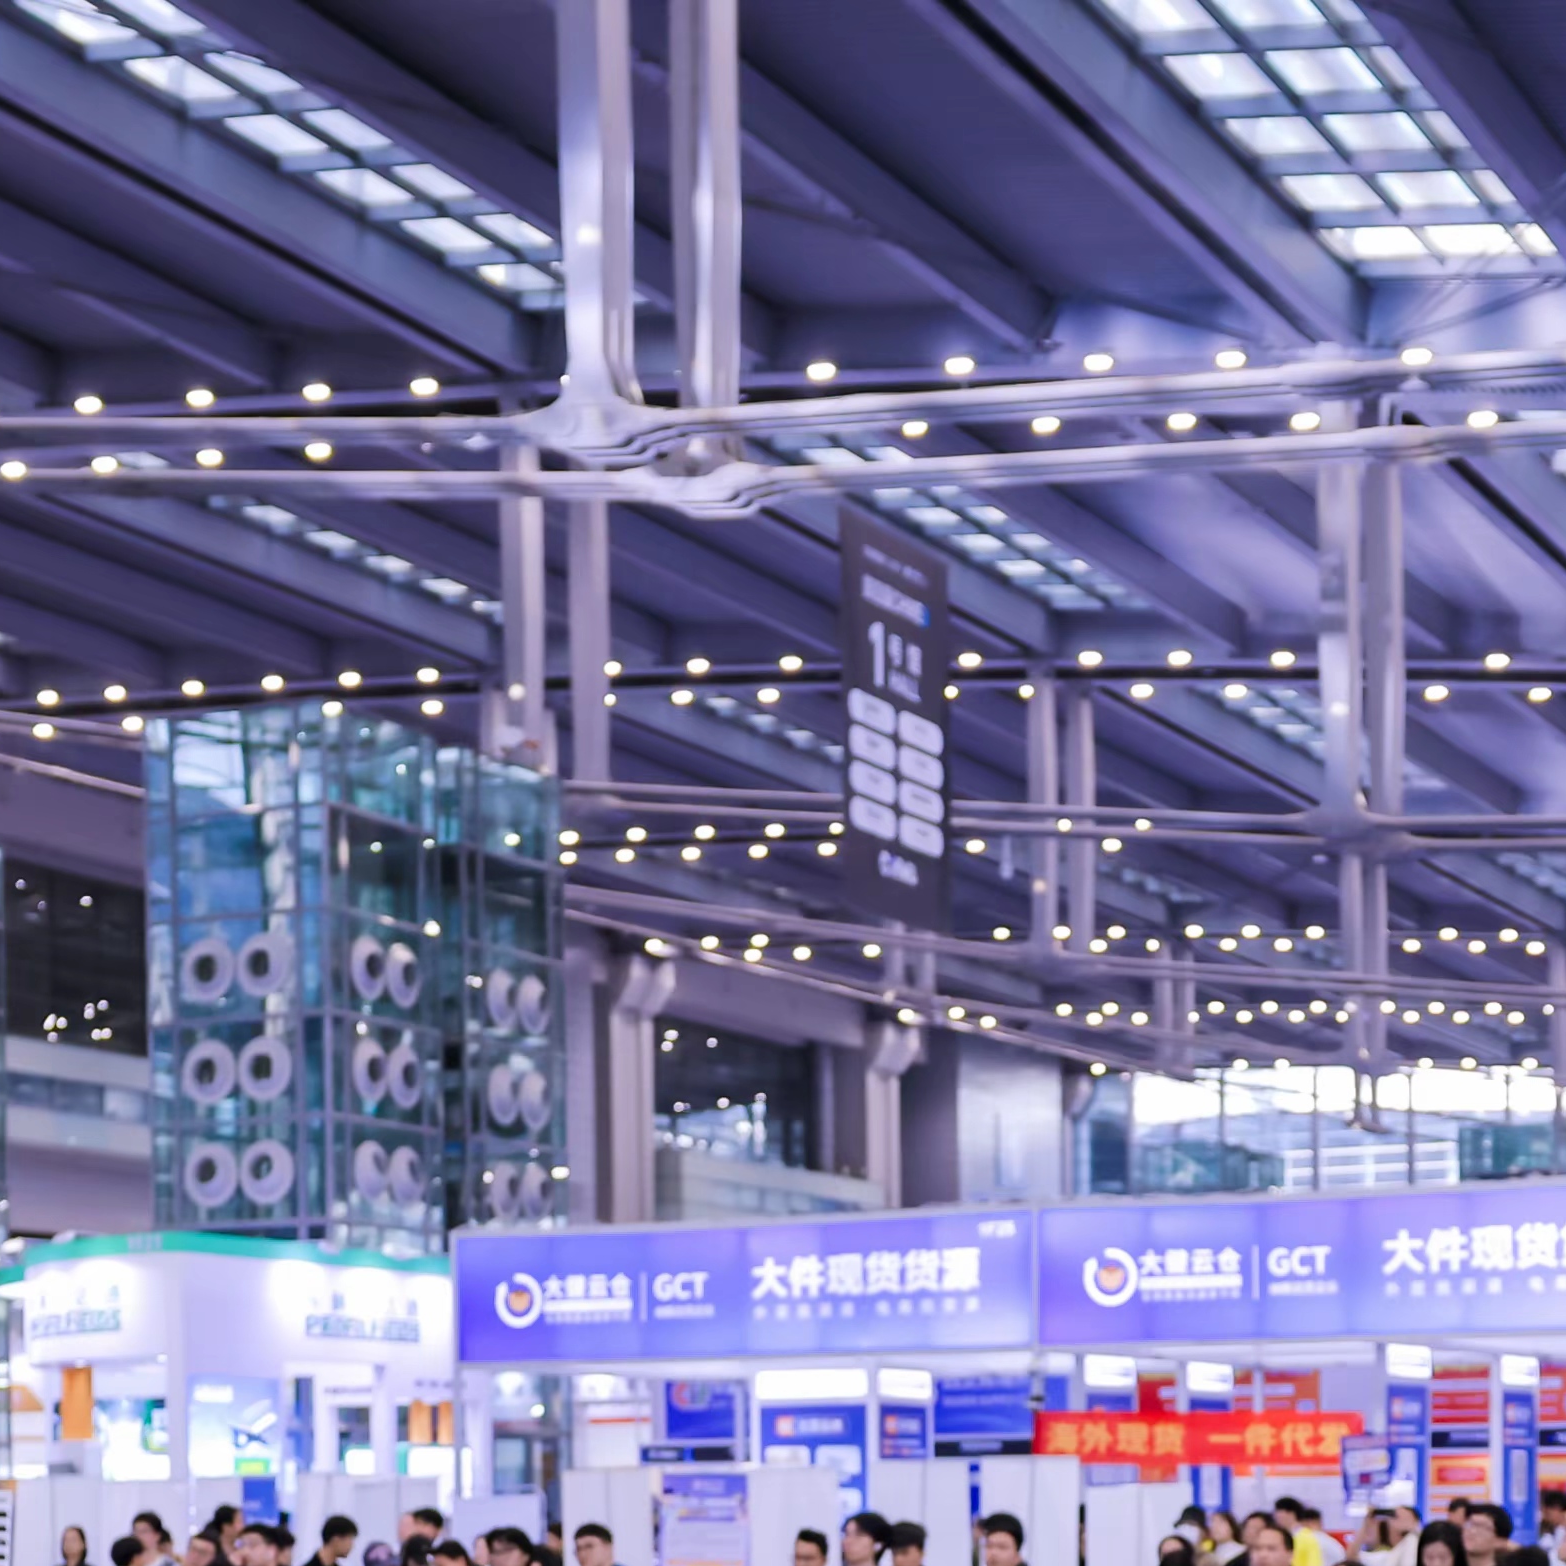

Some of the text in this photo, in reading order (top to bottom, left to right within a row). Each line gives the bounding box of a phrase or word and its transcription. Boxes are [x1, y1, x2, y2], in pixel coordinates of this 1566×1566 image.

[751, 1247, 981, 1300] 大件现货货源
[1267, 1245, 1333, 1278] GCT
[652, 1271, 710, 1302] GCT
